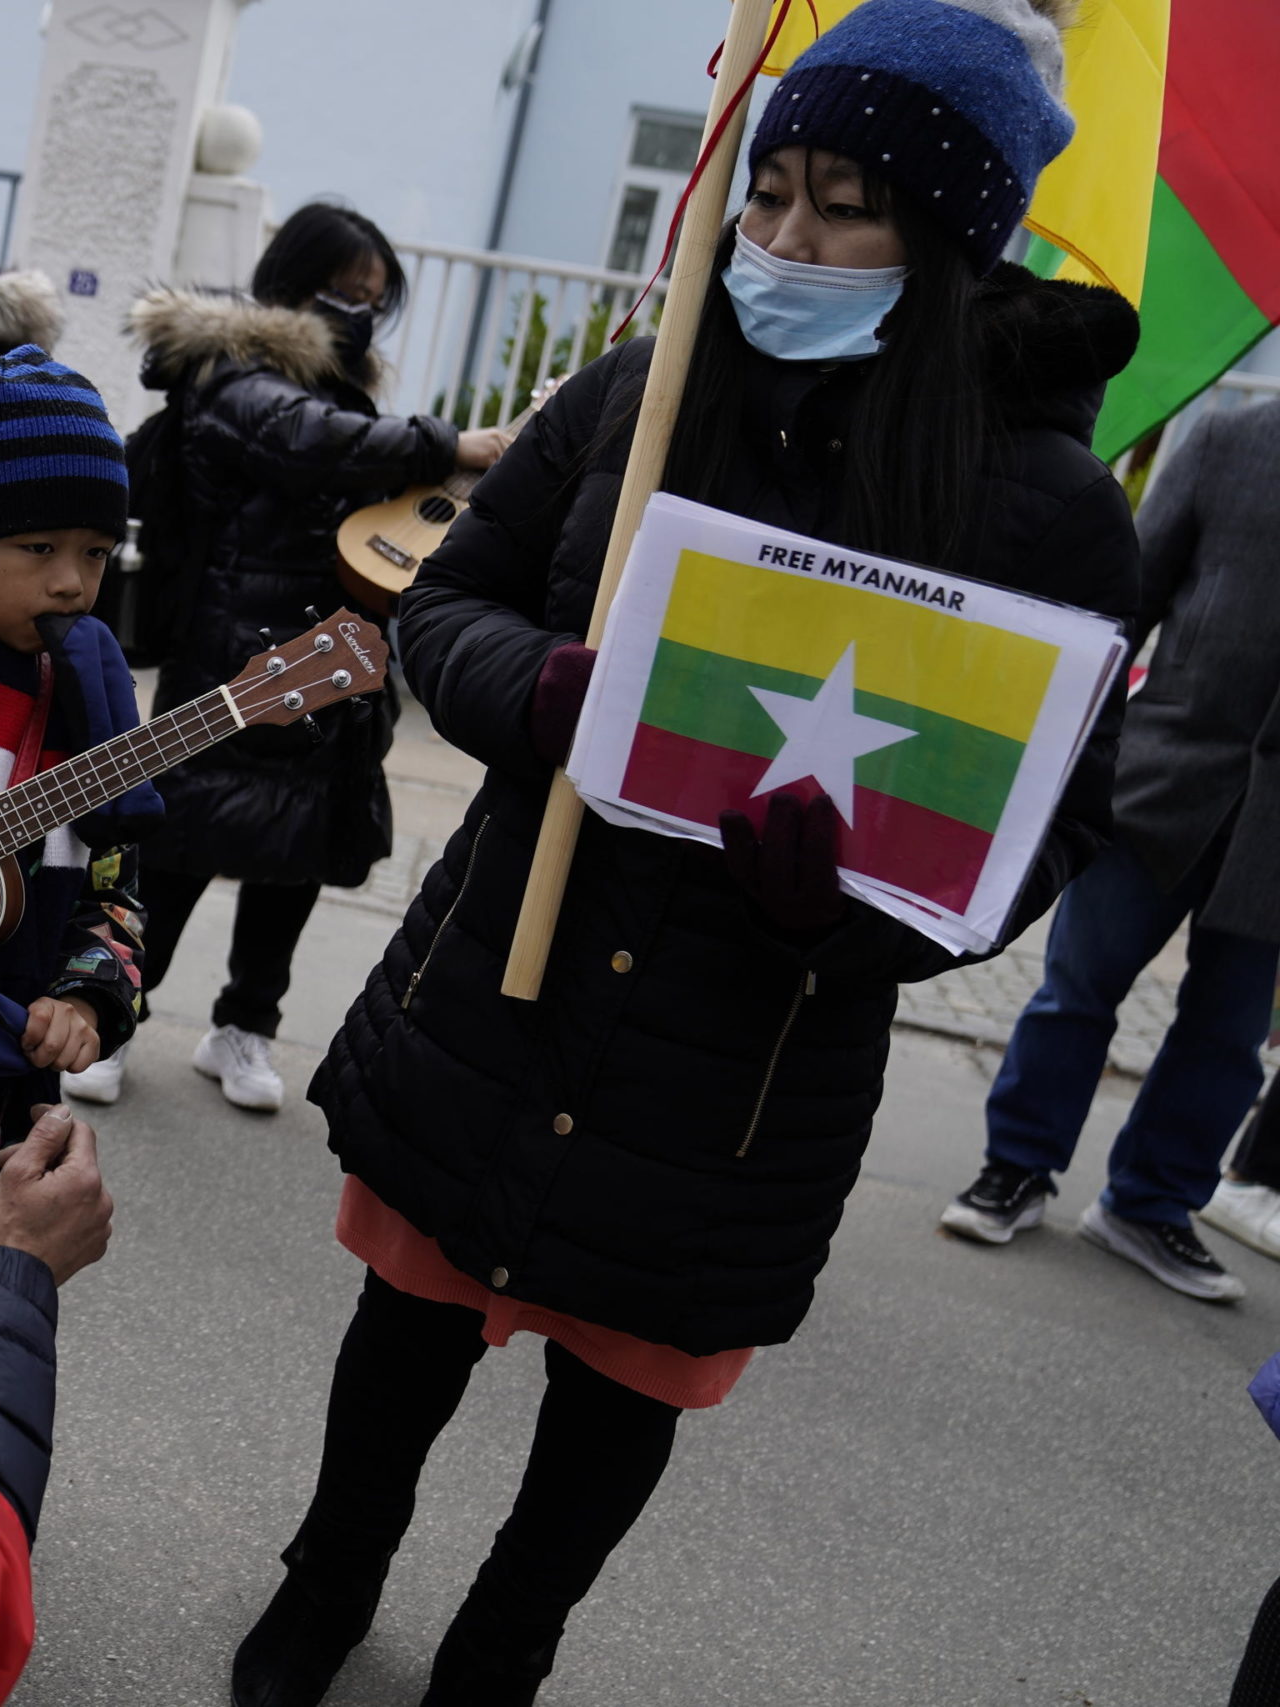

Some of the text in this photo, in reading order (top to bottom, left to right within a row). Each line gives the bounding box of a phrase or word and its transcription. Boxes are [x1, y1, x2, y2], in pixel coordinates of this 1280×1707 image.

[757, 544, 966, 612] FREE MYANMAR
[337, 621, 377, 675] Everdeen
